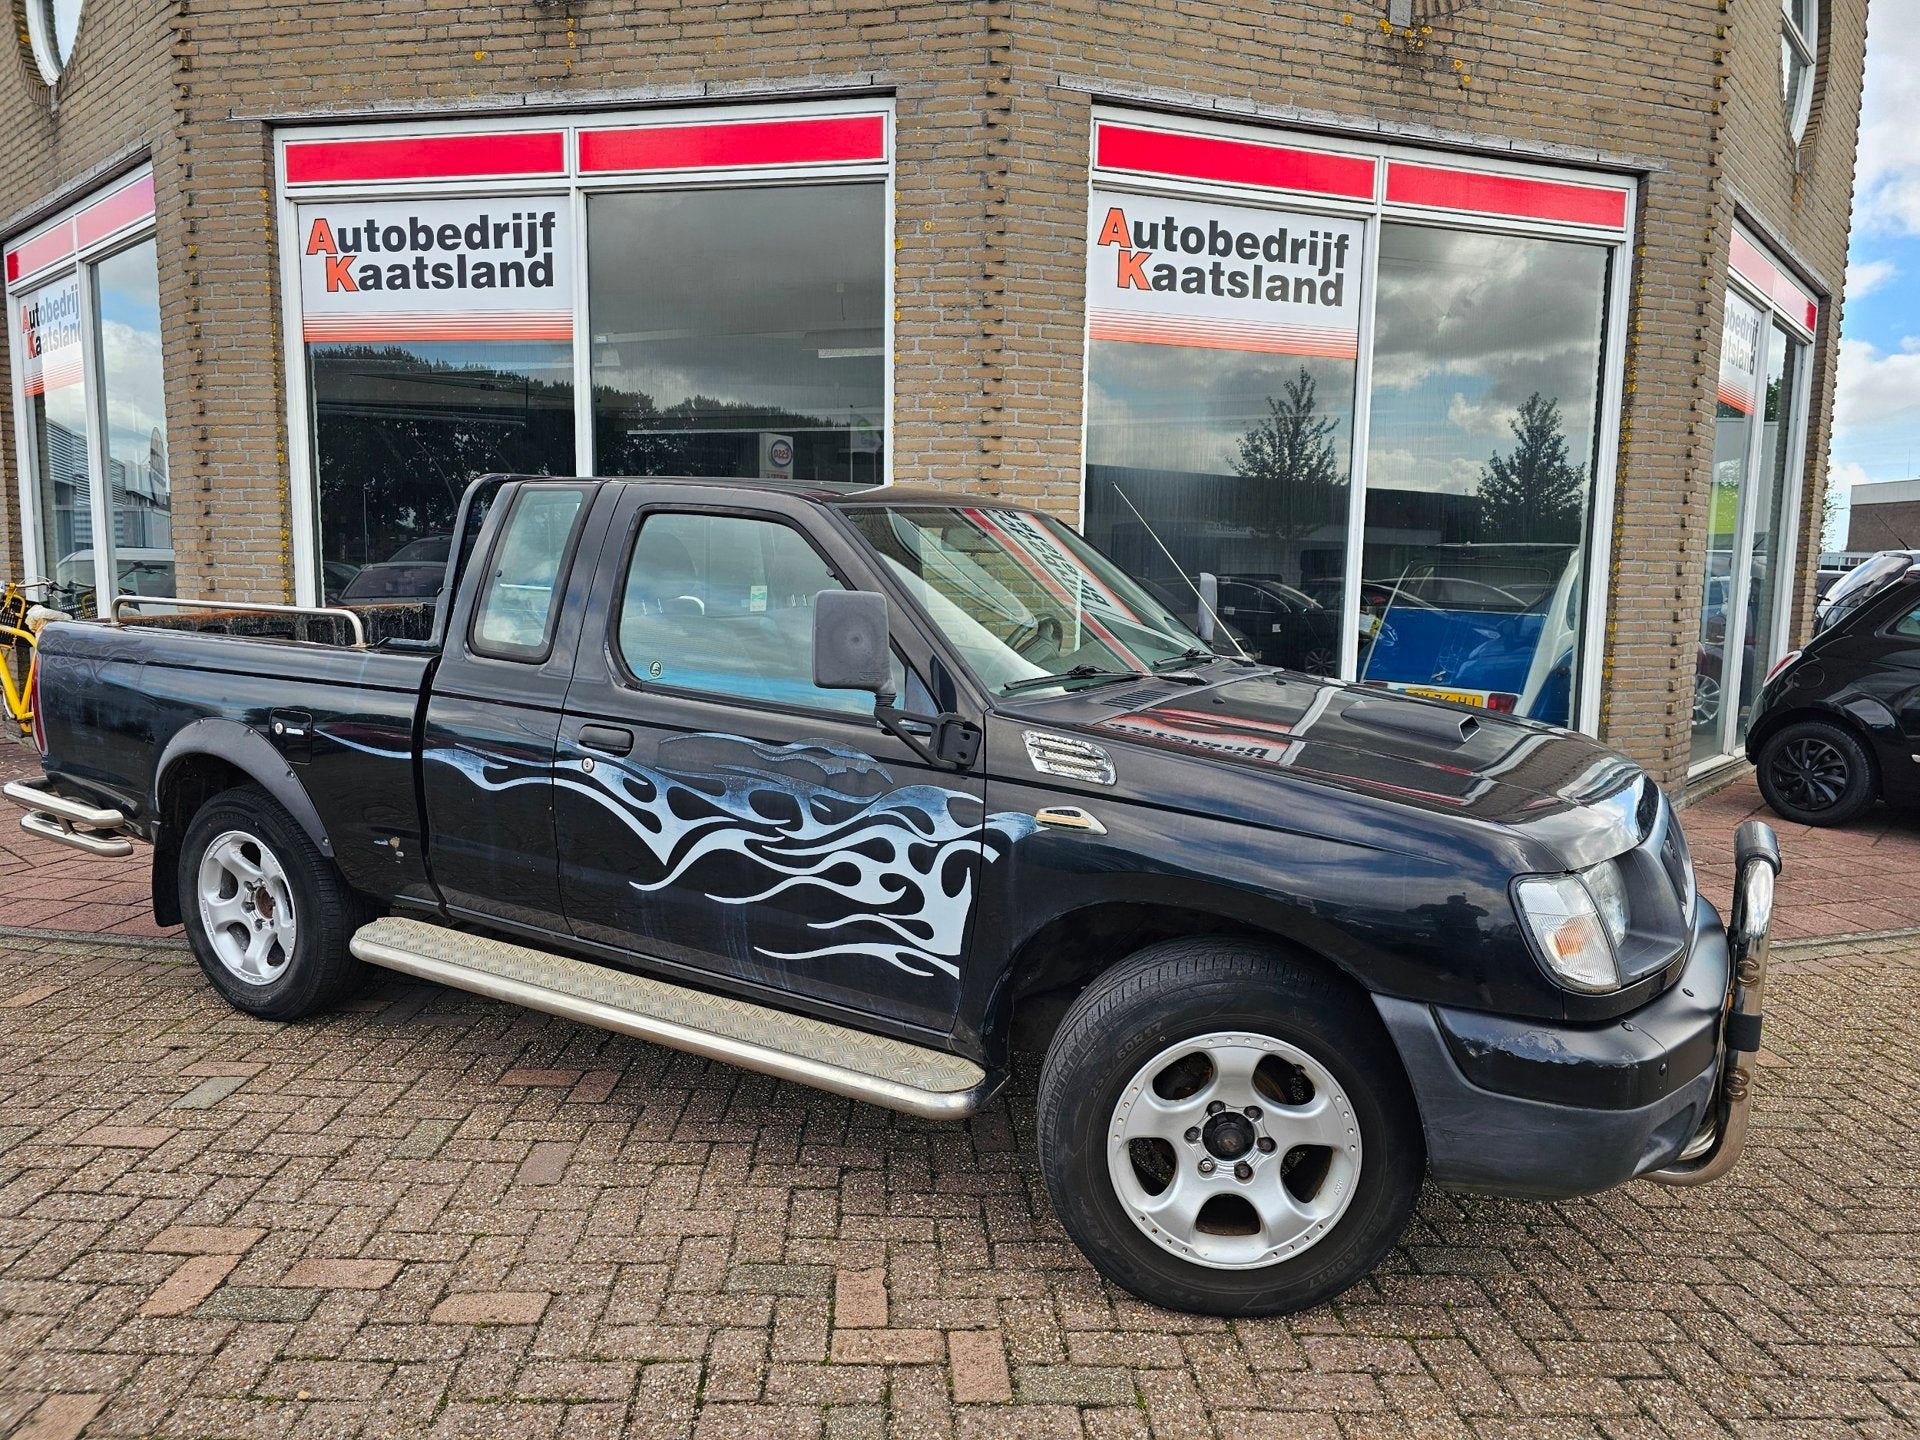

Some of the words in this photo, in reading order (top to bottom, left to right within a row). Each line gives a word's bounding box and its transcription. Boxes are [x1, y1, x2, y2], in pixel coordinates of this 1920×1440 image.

[306, 211, 556, 258] Autobedrijf
[1098, 207, 1349, 276] Autobedrijf
[325, 252, 554, 292] Kaatsland
[1117, 250, 1343, 307] Kaatsland
[22, 284, 79, 334] Autobedrij
[1725, 303, 1759, 353] obedrijf
